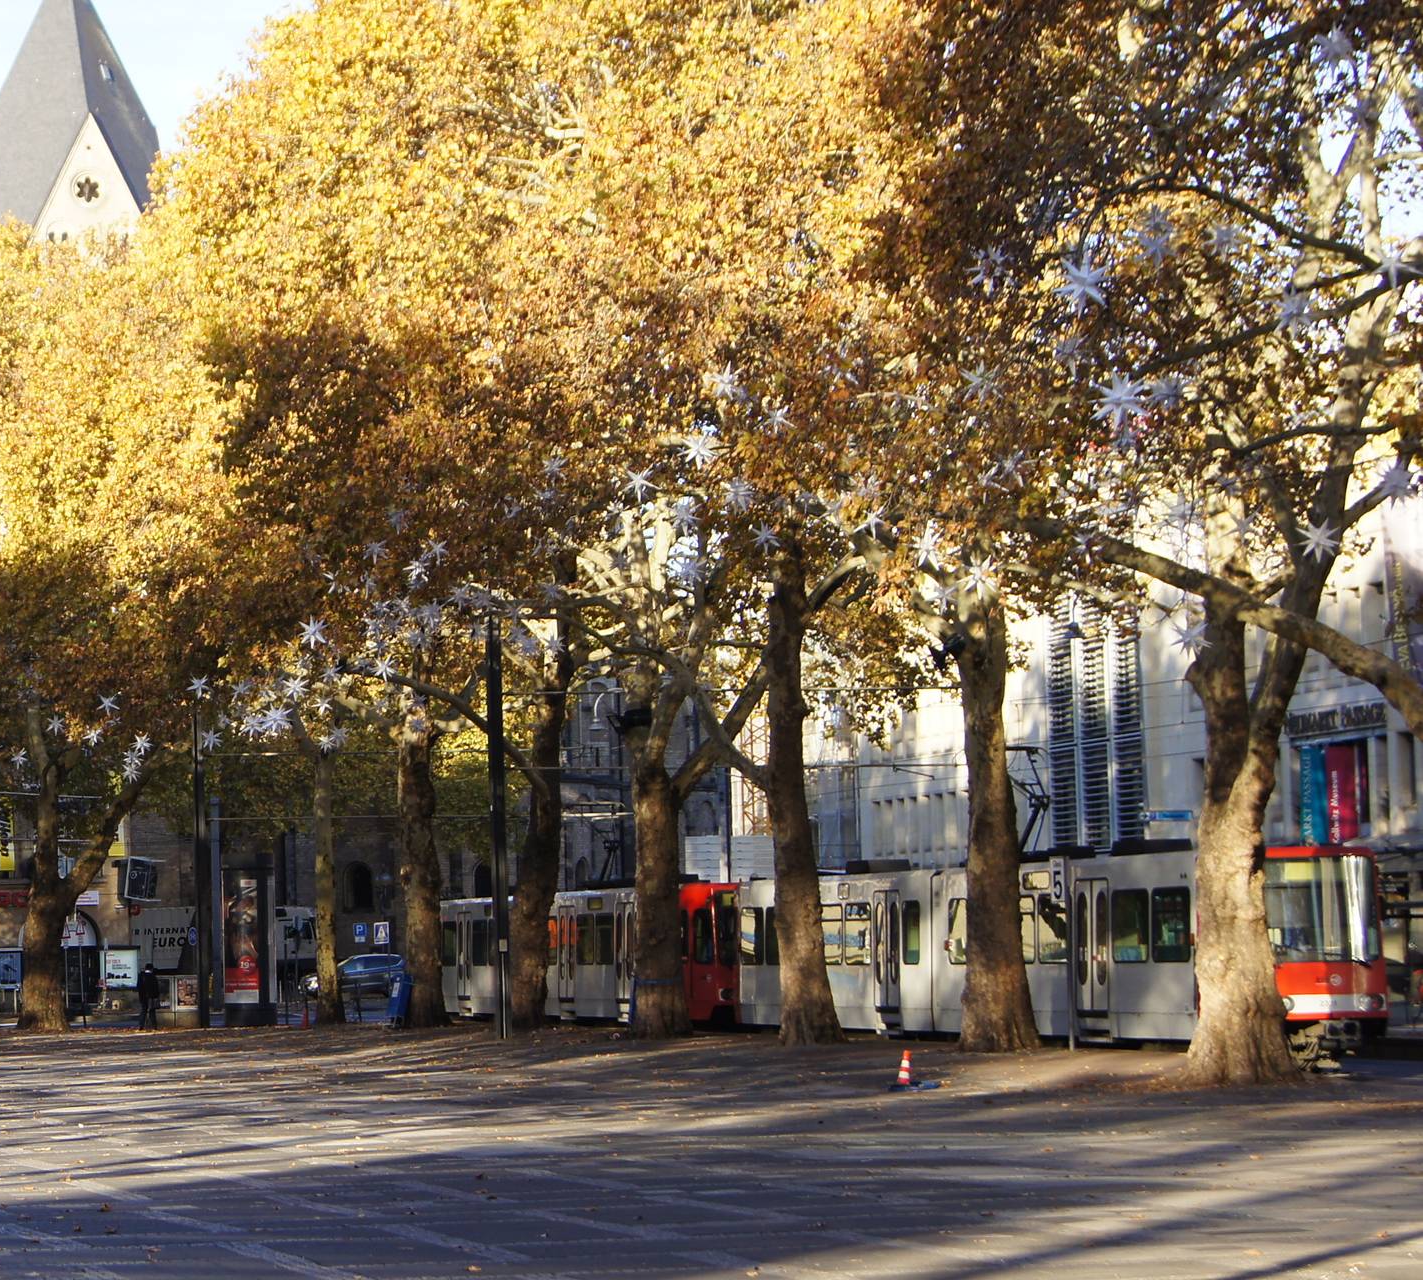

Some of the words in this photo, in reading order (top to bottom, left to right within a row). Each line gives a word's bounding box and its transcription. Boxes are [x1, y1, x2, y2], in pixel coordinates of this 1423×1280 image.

[1302, 753, 1314, 803] PASSAGE
[1330, 770, 1340, 807] Museum
[1303, 808, 1314, 841] ARKT
[1053, 870, 1063, 900] 5
[144, 926, 191, 936] INTERNAT
[356, 925, 364, 935] P
